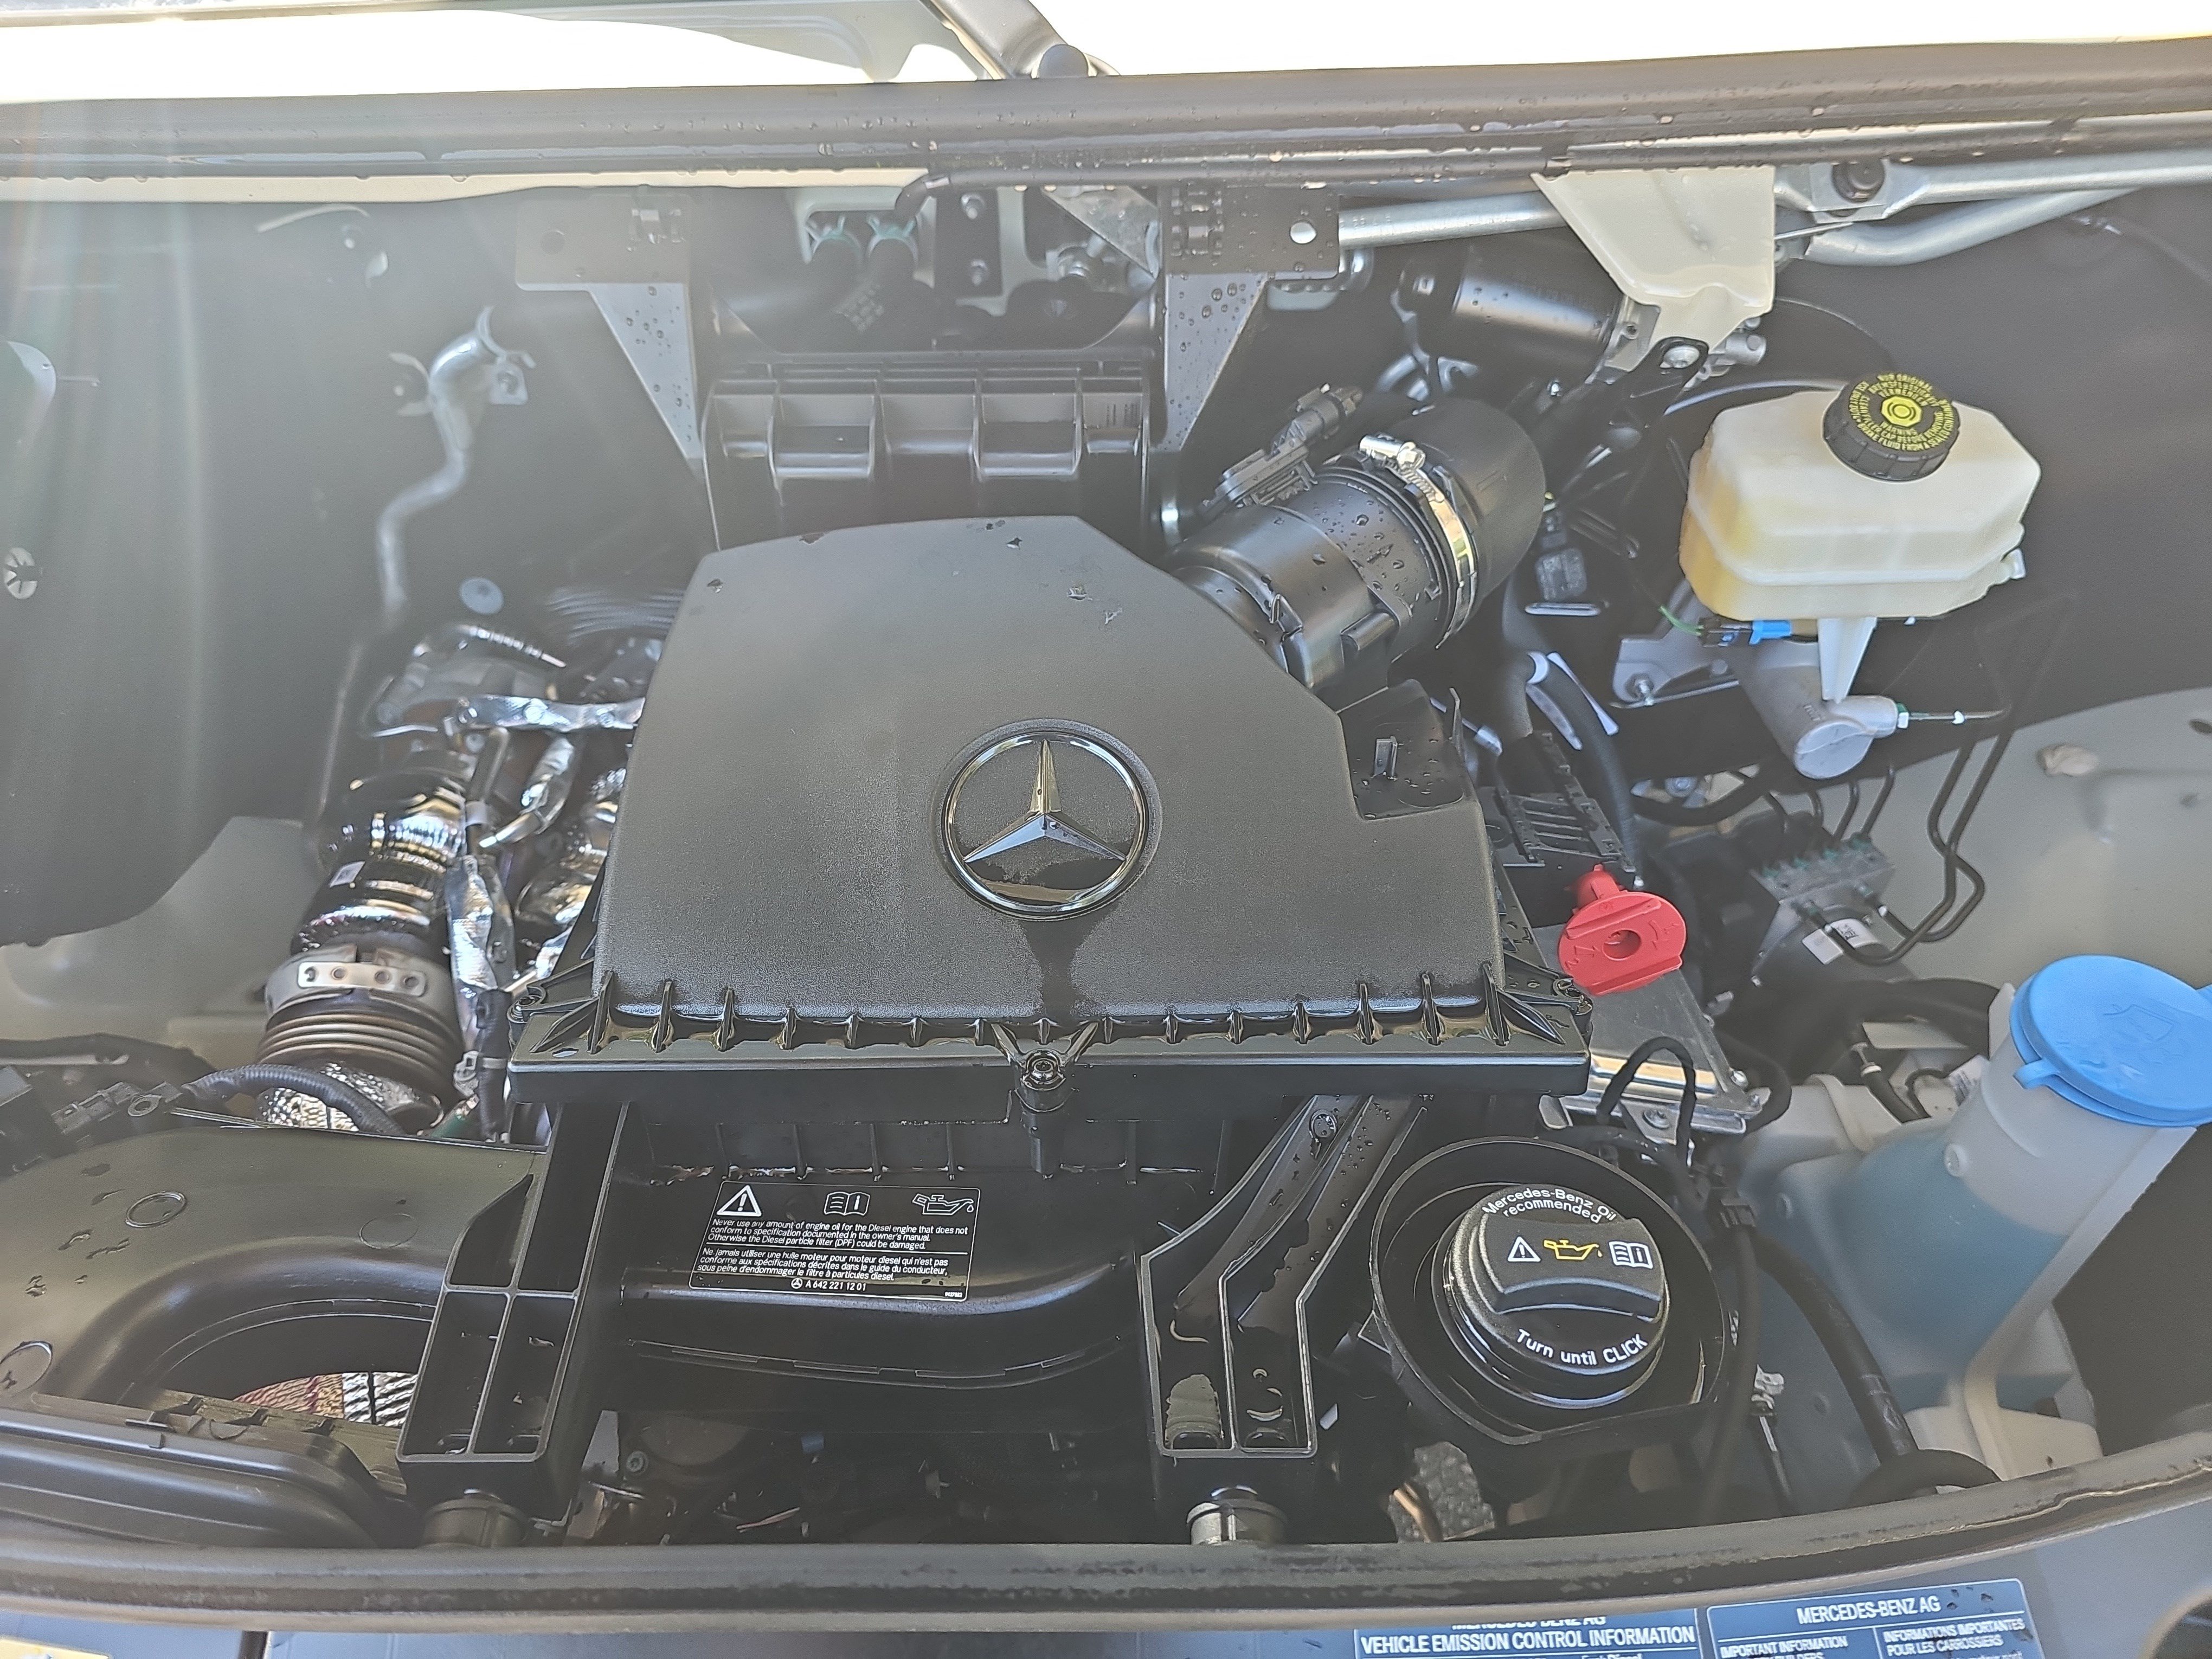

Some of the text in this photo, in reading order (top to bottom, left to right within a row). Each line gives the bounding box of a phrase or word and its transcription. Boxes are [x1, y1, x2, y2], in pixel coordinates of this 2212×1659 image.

[1877, 437, 1901, 449] FLUID
[1880, 430, 1896, 440] CAP
[1482, 1187, 1617, 1221] Mercedes-Benz Oil
[1502, 1198, 1603, 1224] recommended
[710, 1226, 743, 1235] conform
[753, 1227, 801, 1237] specification
[802, 1229, 849, 1239] documented
[872, 1232, 902, 1240] owner's
[903, 1233, 930, 1242] manual.
[712, 1218, 736, 1227] Never
[766, 1221, 794, 1229] amount
[805, 1223, 829, 1231] engine
[841, 1223, 853, 1231] for
[855, 1224, 867, 1232] the
[868, 1224, 891, 1232] Diesel
[892, 1225, 917, 1234] engine
[918, 1225, 934, 1234] that
[935, 1226, 954, 1234] does
[955, 1227, 968, 1235] not
[708, 1233, 747, 1242] Otherwise
[762, 1235, 785, 1244] Diesel
[786, 1237, 814, 1246] particle
[815, 1238, 833, 1246] filter
[834, 1239, 855, 1249] (DPF)
[856, 1240, 877, 1248] could
[889, 1241, 926, 1250] damaged.
[700, 1256, 737, 1264] conforme
[754, 1258, 806, 1268] spécifications
[808, 1260, 840, 1270] décrites
[841, 1263, 859, 1271] dans
[869, 1264, 890, 1273] guide
[892, 1265, 901, 1273] du
[902, 1266, 948, 1276] conducteur,
[702, 1248, 713, 1256] Ne
[715, 1249, 740, 1257] jamais
[741, 1250, 766, 1258] utiliser
[800, 1253, 828, 1261] moteur
[829, 1255, 846, 1263] pour
[848, 1256, 877, 1264] moteur
[878, 1256, 901, 1264] diesel
[902, 1257, 914, 1266] qui
[914, 1258, 933, 1266] n'est
[934, 1259, 948, 1267] pas
[717, 1264, 738, 1273] peine
[739, 1265, 796, 1276] d'endommager
[797, 1268, 803, 1276] le
[805, 1269, 824, 1277] filtre
[825, 1269, 831, 1277] à
[832, 1270, 870, 1279] particules
[871, 1272, 895, 1281] diesel.
[806, 1280, 866, 1291] A 642 221 12 01
[1516, 1328, 1648, 1366] Turn until CLICK
[1796, 1595, 1942, 1624] MERCEDES-BENZ AG
[1360, 1625, 1696, 1654] VEHICLE EMISSION CONTROL INFORMATION
[1882, 1617, 2026, 1643] INFORMATIONS IMPORTANTES
[1720, 1635, 1849, 1659] IMPORTANT INFORMATION
[1886, 1643, 1917, 1657] POUR
[1917, 1641, 1936, 1654] LES
